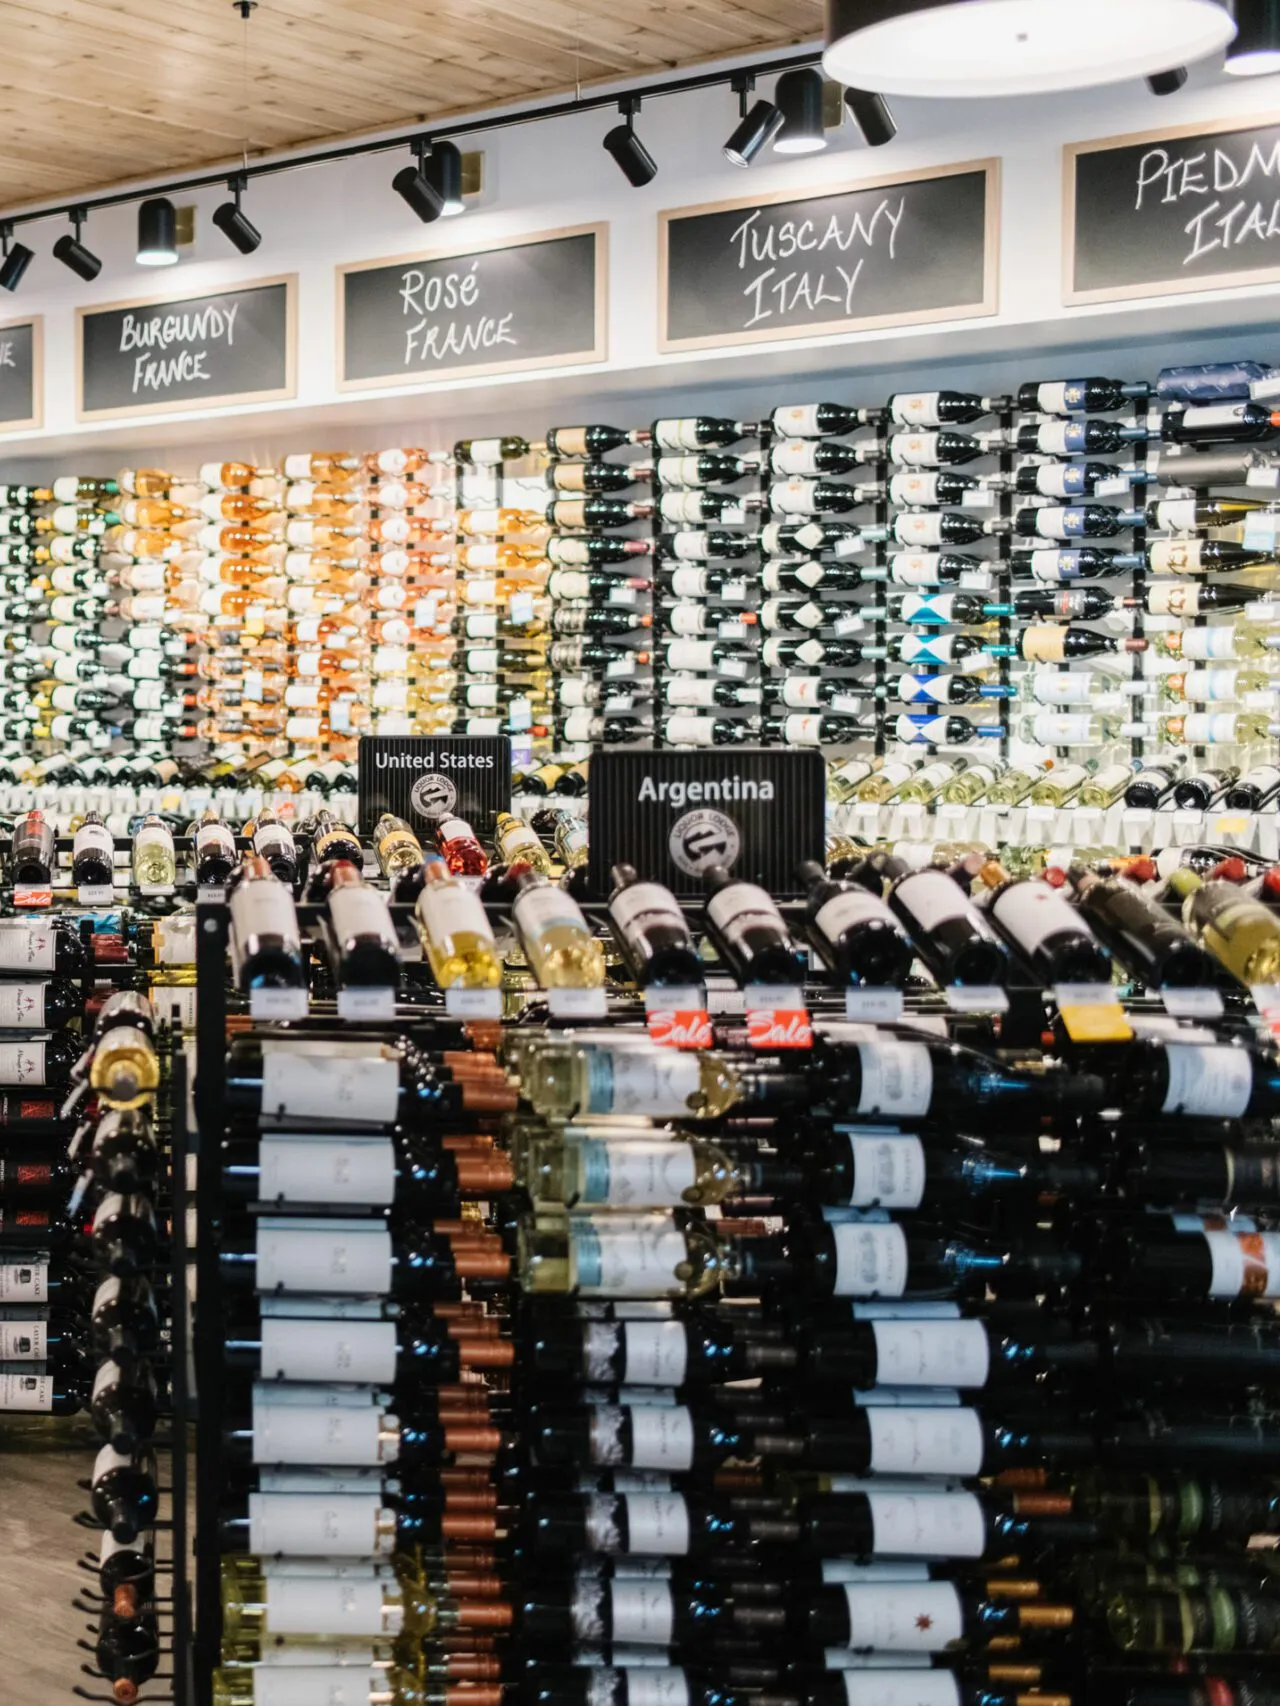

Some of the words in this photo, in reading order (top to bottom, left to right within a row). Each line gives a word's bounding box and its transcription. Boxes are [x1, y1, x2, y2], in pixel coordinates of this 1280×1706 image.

[729, 197, 907, 270] TUSCANY
[742, 258, 863, 330] ITALY
[119, 304, 239, 352] BURGUNDY
[403, 312, 518, 366] FRANCE
[132, 351, 212, 393] FRANCE
[375, 752, 435, 769] United
[439, 752, 494, 769] States
[638, 776, 775, 807] Argentina
[673, 812, 703, 838] LIQUOR
[13, 891, 52, 906] Sale
[647, 1010, 713, 1045] Sale
[746, 1009, 813, 1044] Sale
